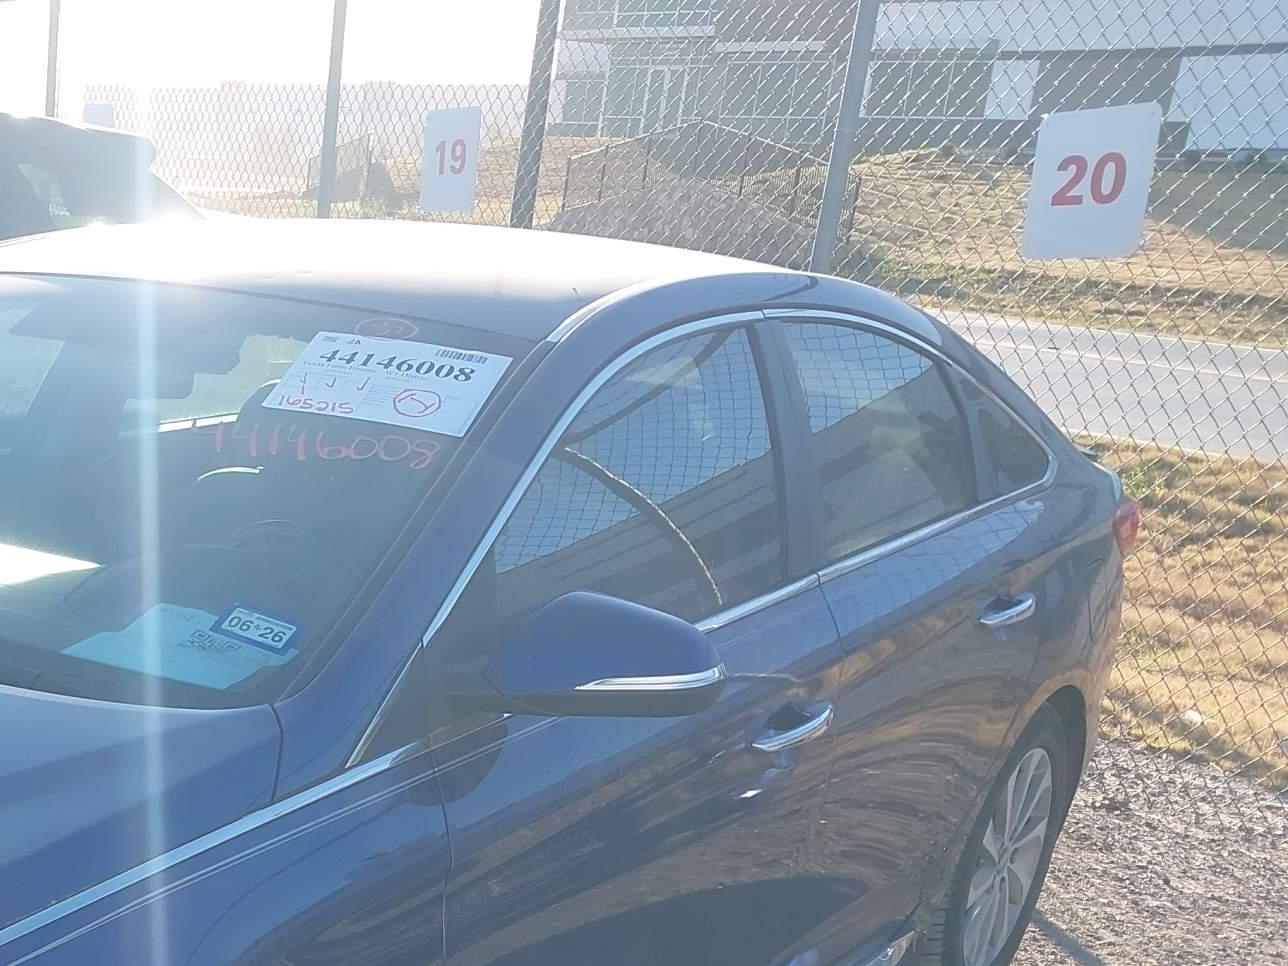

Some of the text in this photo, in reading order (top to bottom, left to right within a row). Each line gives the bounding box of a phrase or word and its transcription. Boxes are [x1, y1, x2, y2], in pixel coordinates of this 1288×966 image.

[435, 138, 467, 175] 19
[1050, 151, 1127, 206] 20
[319, 348, 476, 383] 44146008
[228, 615, 254, 632] 06
[258, 626, 287, 643] 26
